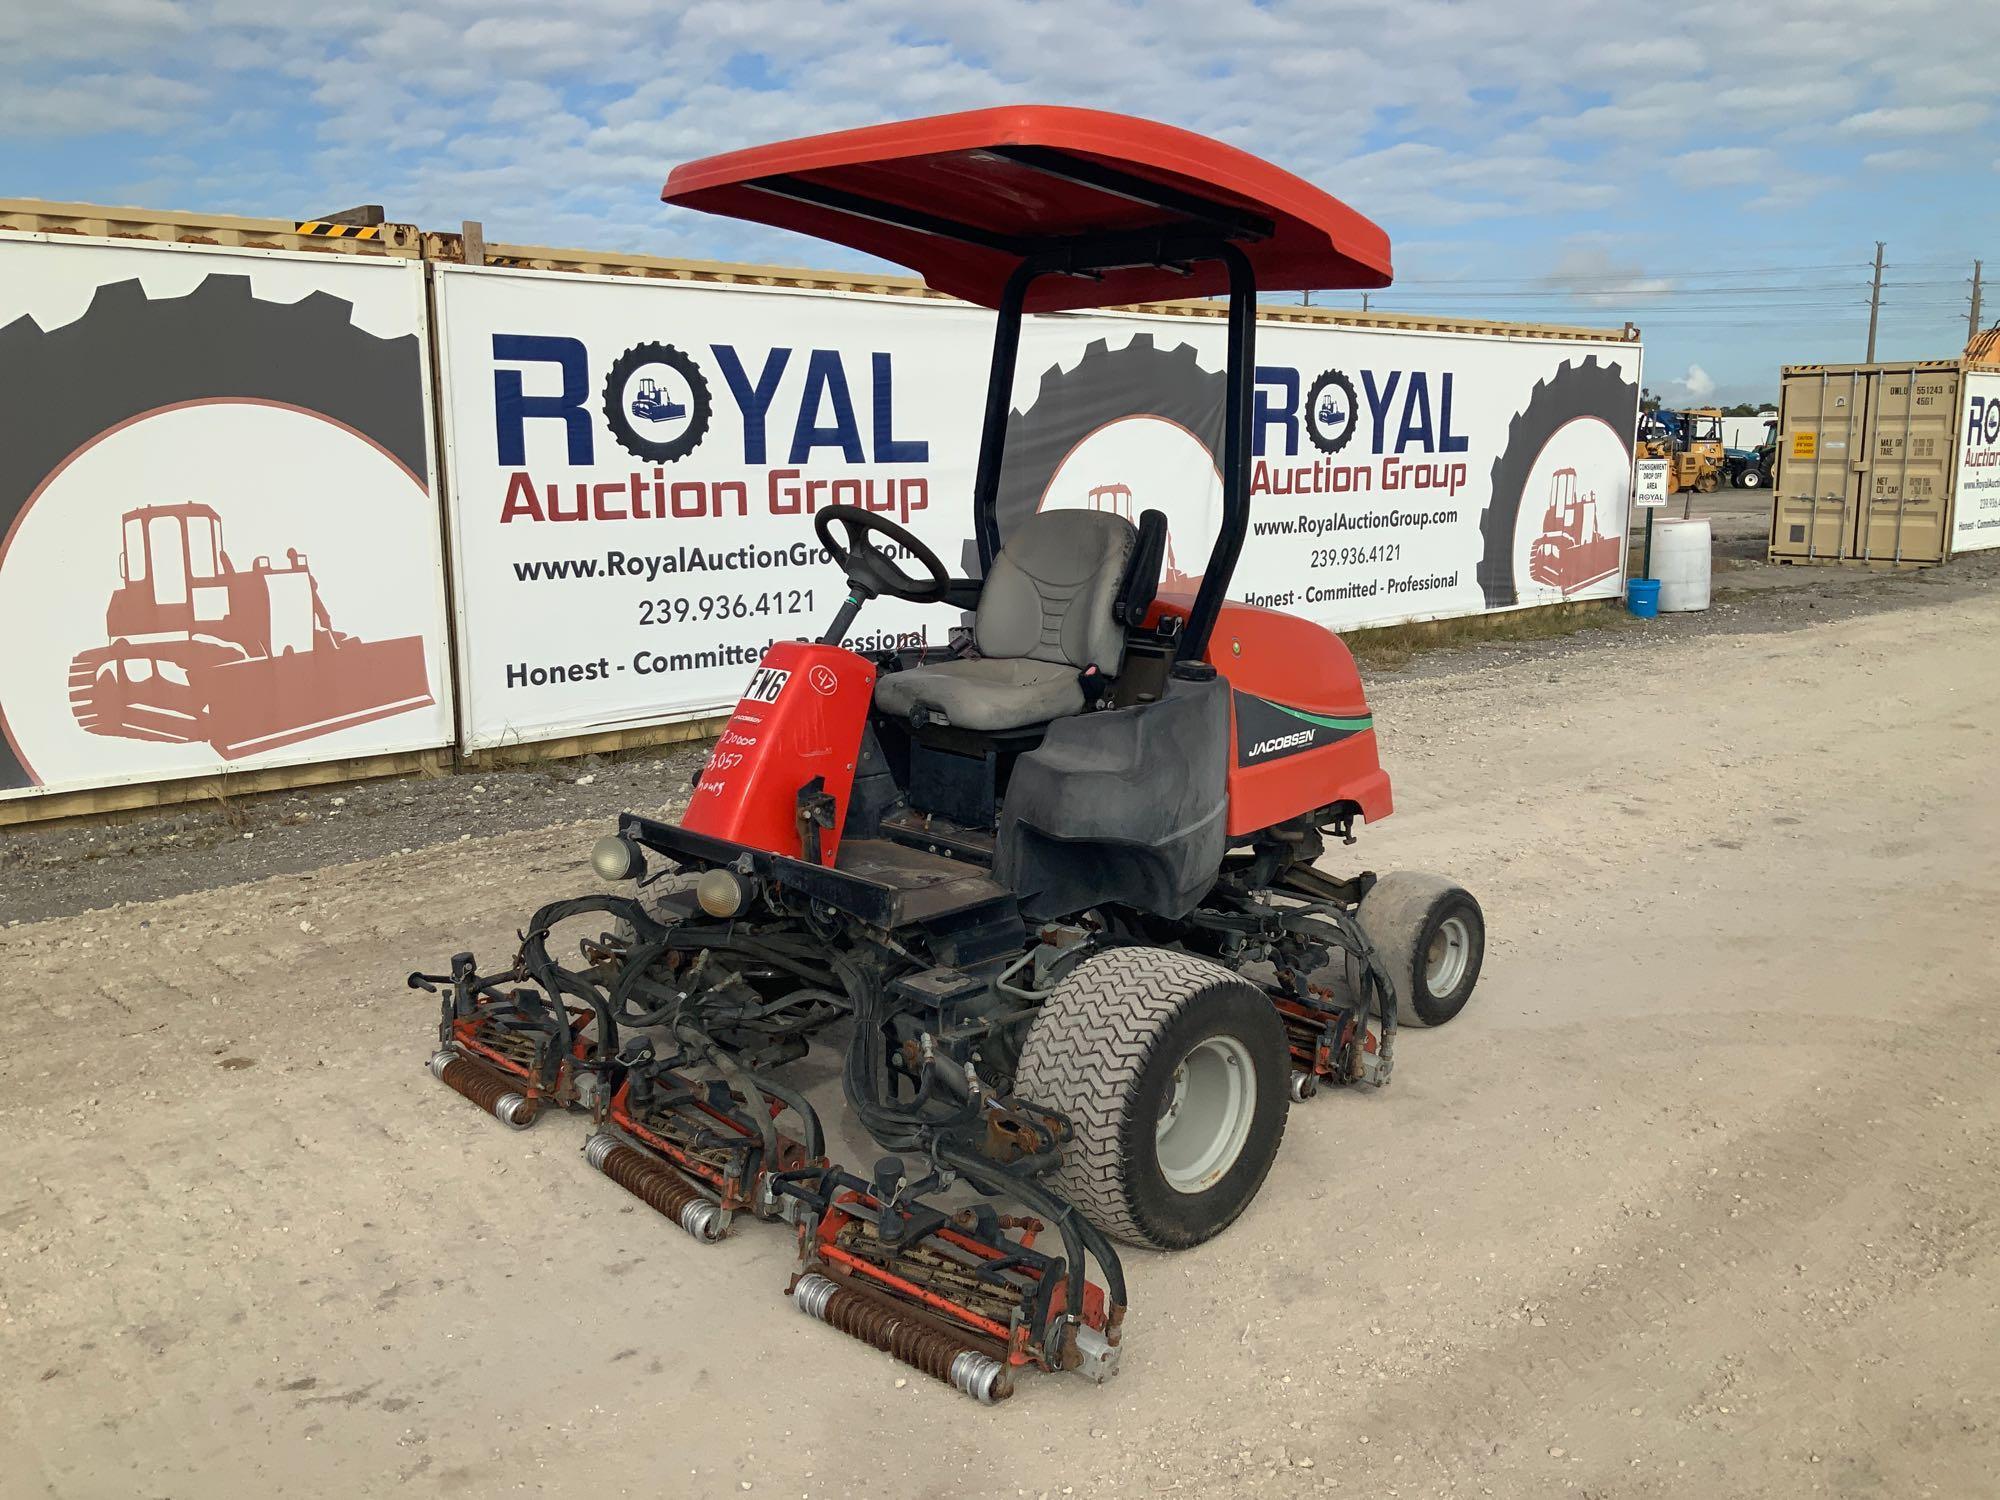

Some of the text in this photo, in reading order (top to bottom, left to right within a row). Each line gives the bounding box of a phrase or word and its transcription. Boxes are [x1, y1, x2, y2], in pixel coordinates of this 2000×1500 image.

[492, 333, 929, 466] ROYAL
[1916, 386, 1943, 395] 551243
[1252, 366, 1469, 456] ROYAL
[1880, 438, 1893, 447] MAX
[1250, 457, 1467, 497] Auction Group
[1876, 476, 1888, 486] NET
[500, 467, 929, 524] Auction Group
[1253, 509, 1458, 537] www.RoyalAuctionGroup.com
[1310, 543, 1401, 568] 239.936.4121
[1245, 590, 1294, 607] Honest
[1306, 579, 1377, 603] Committed
[1387, 571, 1458, 594] Professional
[639, 589, 815, 625] 239.936.4121
[506, 657, 609, 688] Honest
[816, 670, 835, 690] 47
[1248, 728, 1316, 757] JACOBSEN
